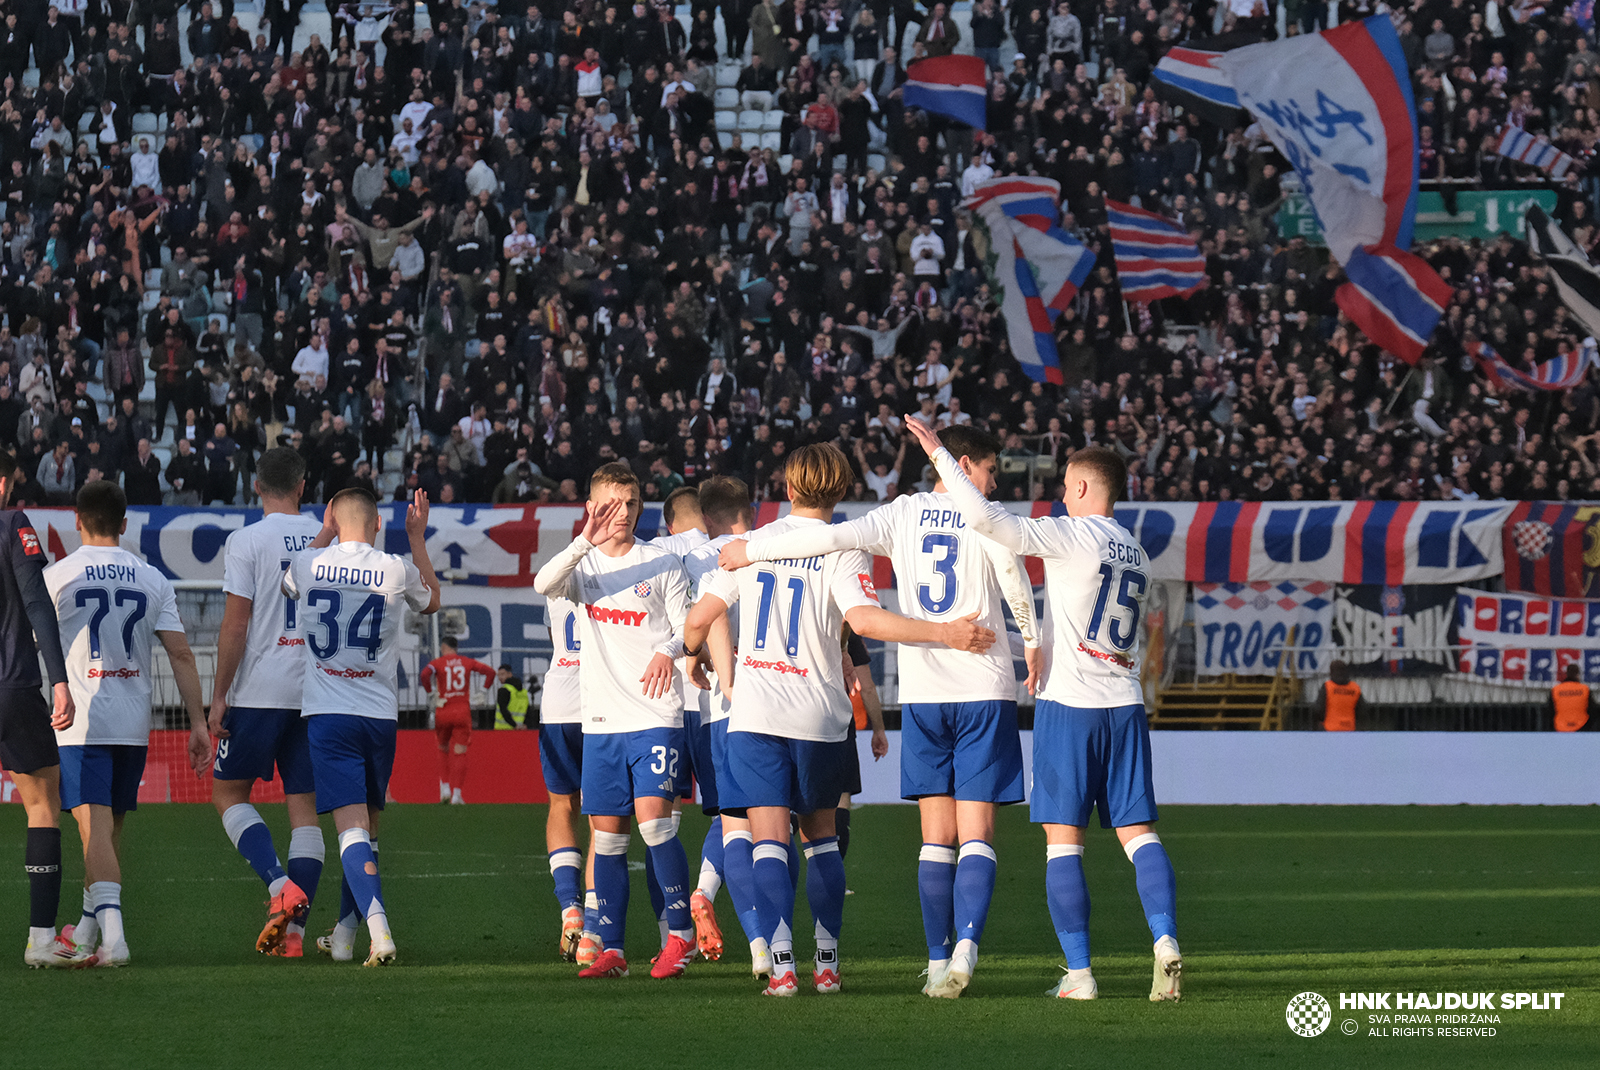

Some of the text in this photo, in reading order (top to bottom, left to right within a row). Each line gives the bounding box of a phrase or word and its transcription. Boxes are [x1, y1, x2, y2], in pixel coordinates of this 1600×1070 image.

[1108, 538, 1141, 567] ŠEGO
[85, 564, 136, 583] RUSYN
[315, 565, 384, 587] DURDOV
[918, 531, 960, 615] 3
[585, 603, 648, 627] TOMMY
[753, 569, 806, 659] 11
[1085, 562, 1148, 651] 15
[73, 586, 148, 662] 77
[306, 587, 388, 663] 34
[316, 662, 375, 679] perSport
[444, 665, 466, 690] 13
[743, 655, 809, 678] SuperSport
[650, 745, 679, 779] 32
